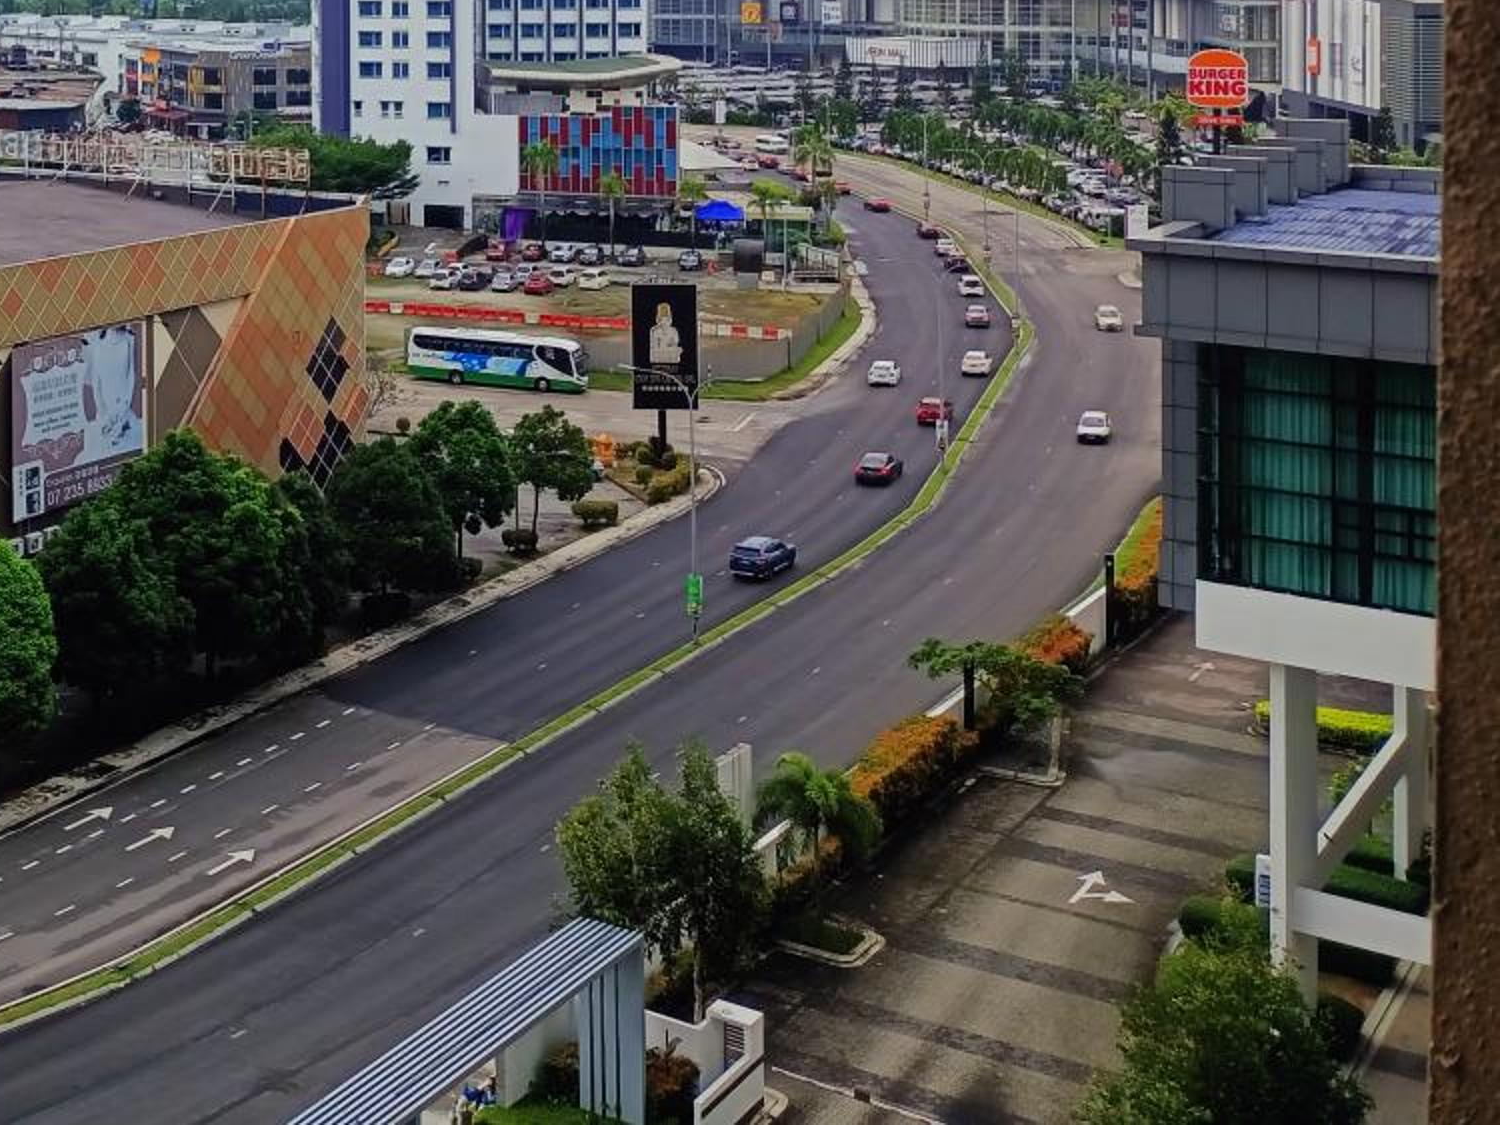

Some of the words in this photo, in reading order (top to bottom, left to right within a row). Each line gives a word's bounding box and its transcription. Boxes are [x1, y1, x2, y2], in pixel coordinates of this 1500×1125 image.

[1189, 68, 1247, 80] BURGER
[1189, 80, 1247, 96] KING
[47, 489, 60, 506] 07
[63, 482, 85, 502] 235
